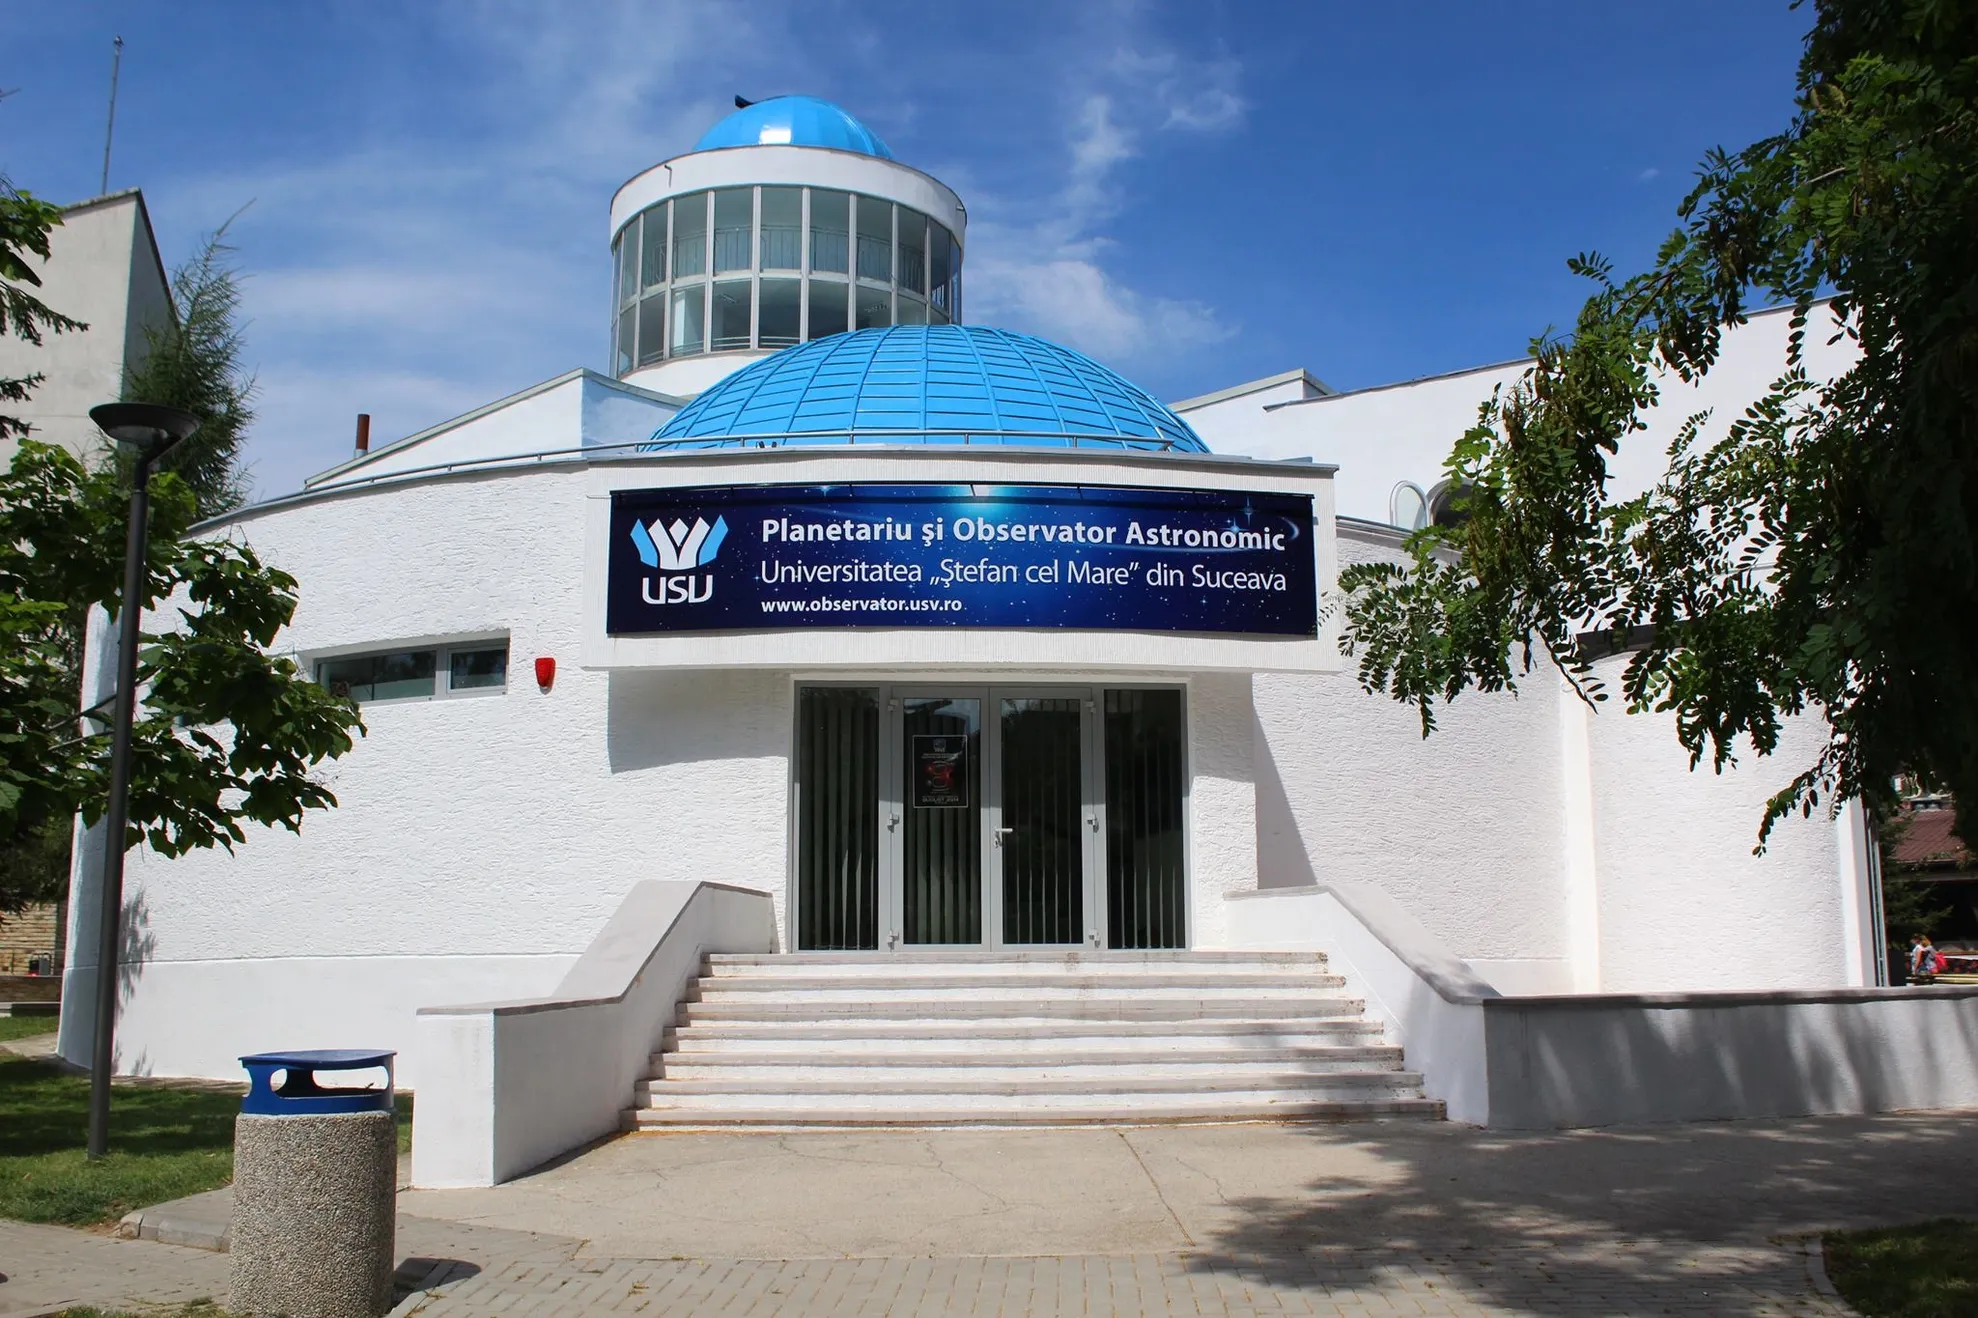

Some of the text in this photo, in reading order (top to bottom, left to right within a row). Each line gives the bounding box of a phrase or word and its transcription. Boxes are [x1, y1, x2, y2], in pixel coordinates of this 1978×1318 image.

[762, 517, 912, 543] Planetariu
[953, 517, 1117, 544] Observator
[1125, 521, 1286, 551] Astronomic
[761, 560, 922, 584] Universitatea
[1025, 559, 1059, 583] cel
[1146, 562, 1184, 587] din
[1192, 564, 1286, 591] Suceava
[761, 596, 963, 613] www.observator.usv.ro
